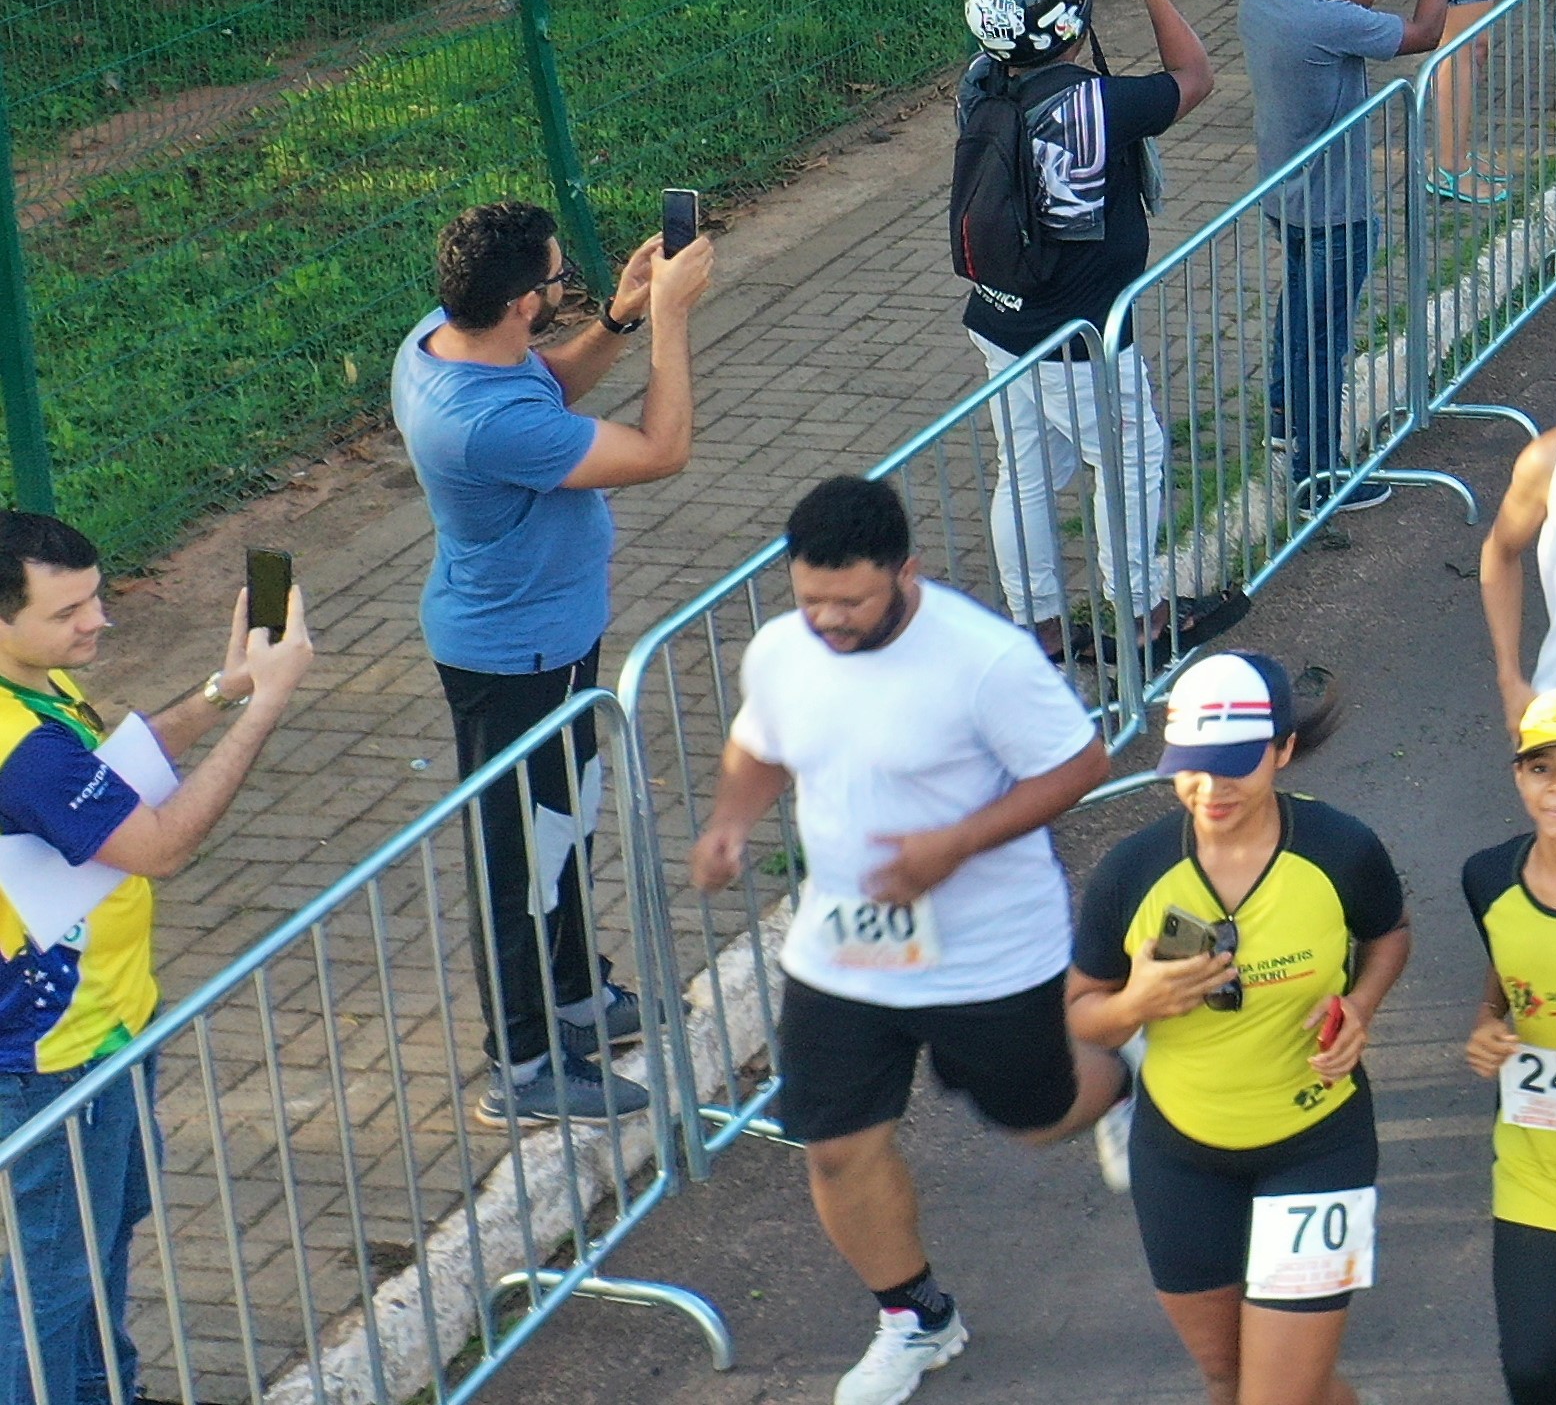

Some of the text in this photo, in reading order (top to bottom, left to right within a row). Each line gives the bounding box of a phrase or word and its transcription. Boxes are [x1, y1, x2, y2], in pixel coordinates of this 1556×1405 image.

[69, 763, 110, 811] HONDA
[822, 903, 916, 944] 180
[1257, 949, 1314, 972] RUNNERS
[1287, 1202, 1348, 1253] 70
